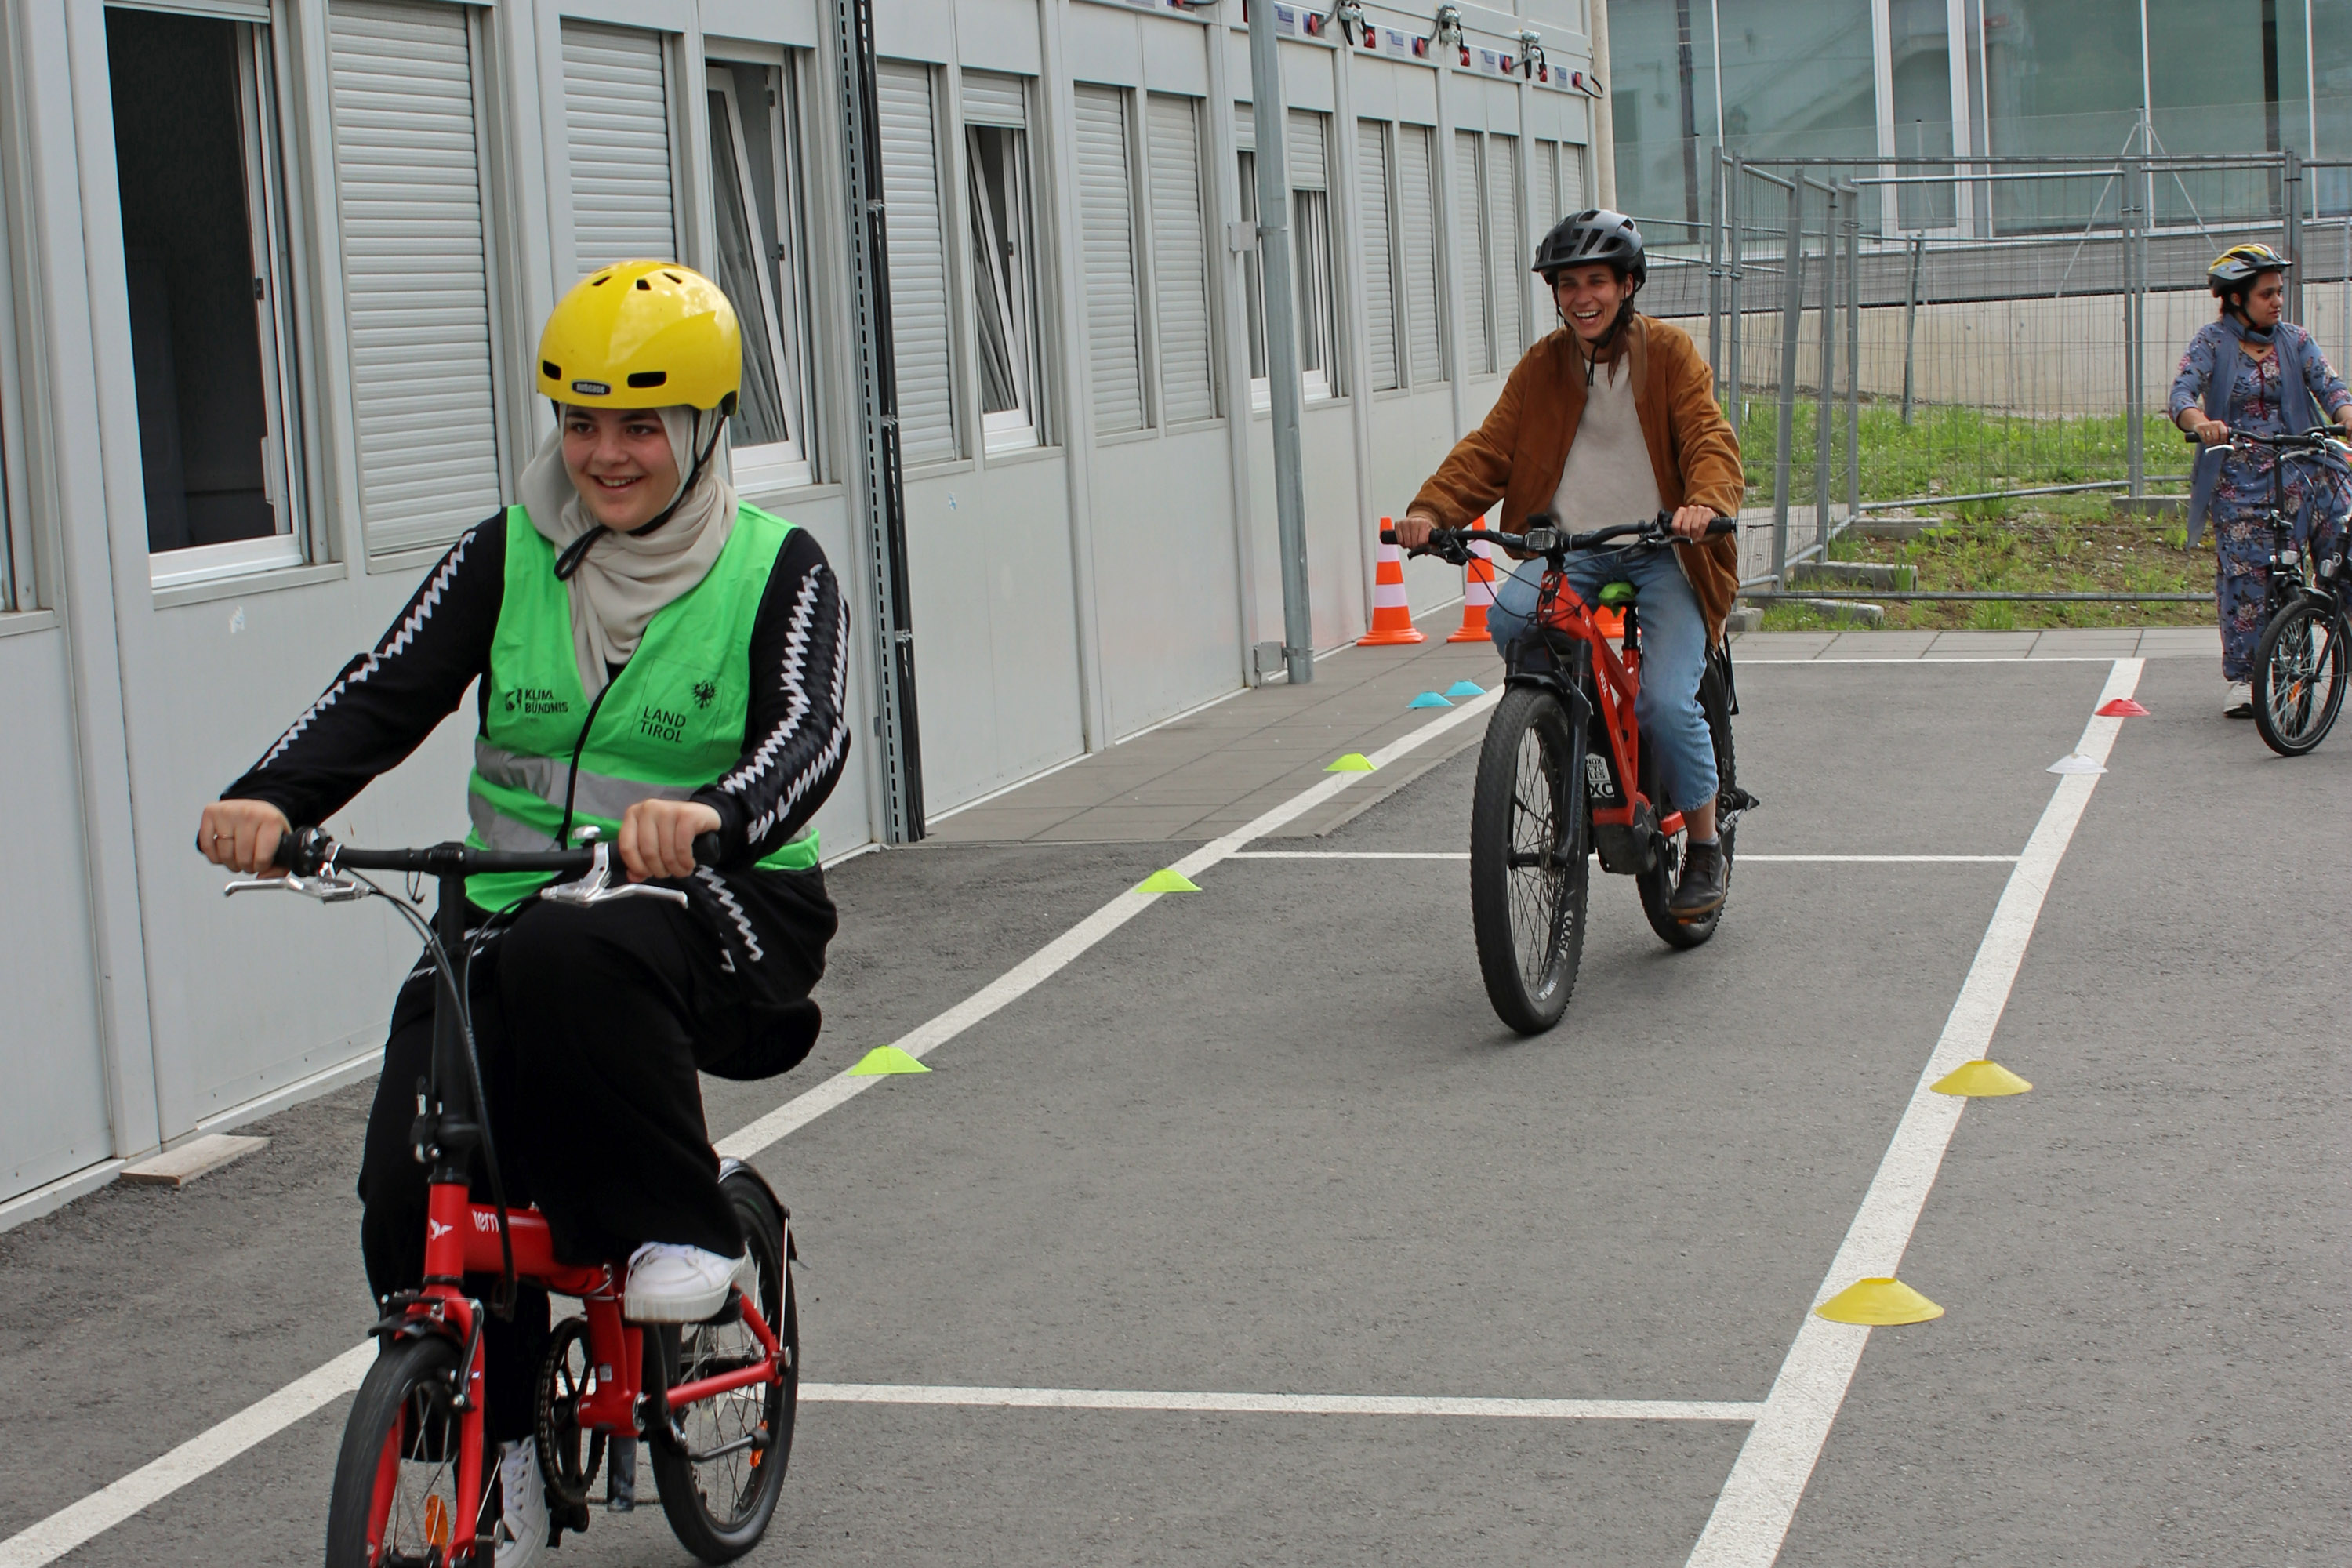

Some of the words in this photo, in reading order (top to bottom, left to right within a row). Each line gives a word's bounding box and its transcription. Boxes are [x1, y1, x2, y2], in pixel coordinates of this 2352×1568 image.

[644, 705, 687, 728] LAND
[641, 719, 683, 743] TIROL
[1589, 783, 1615, 797] XC
